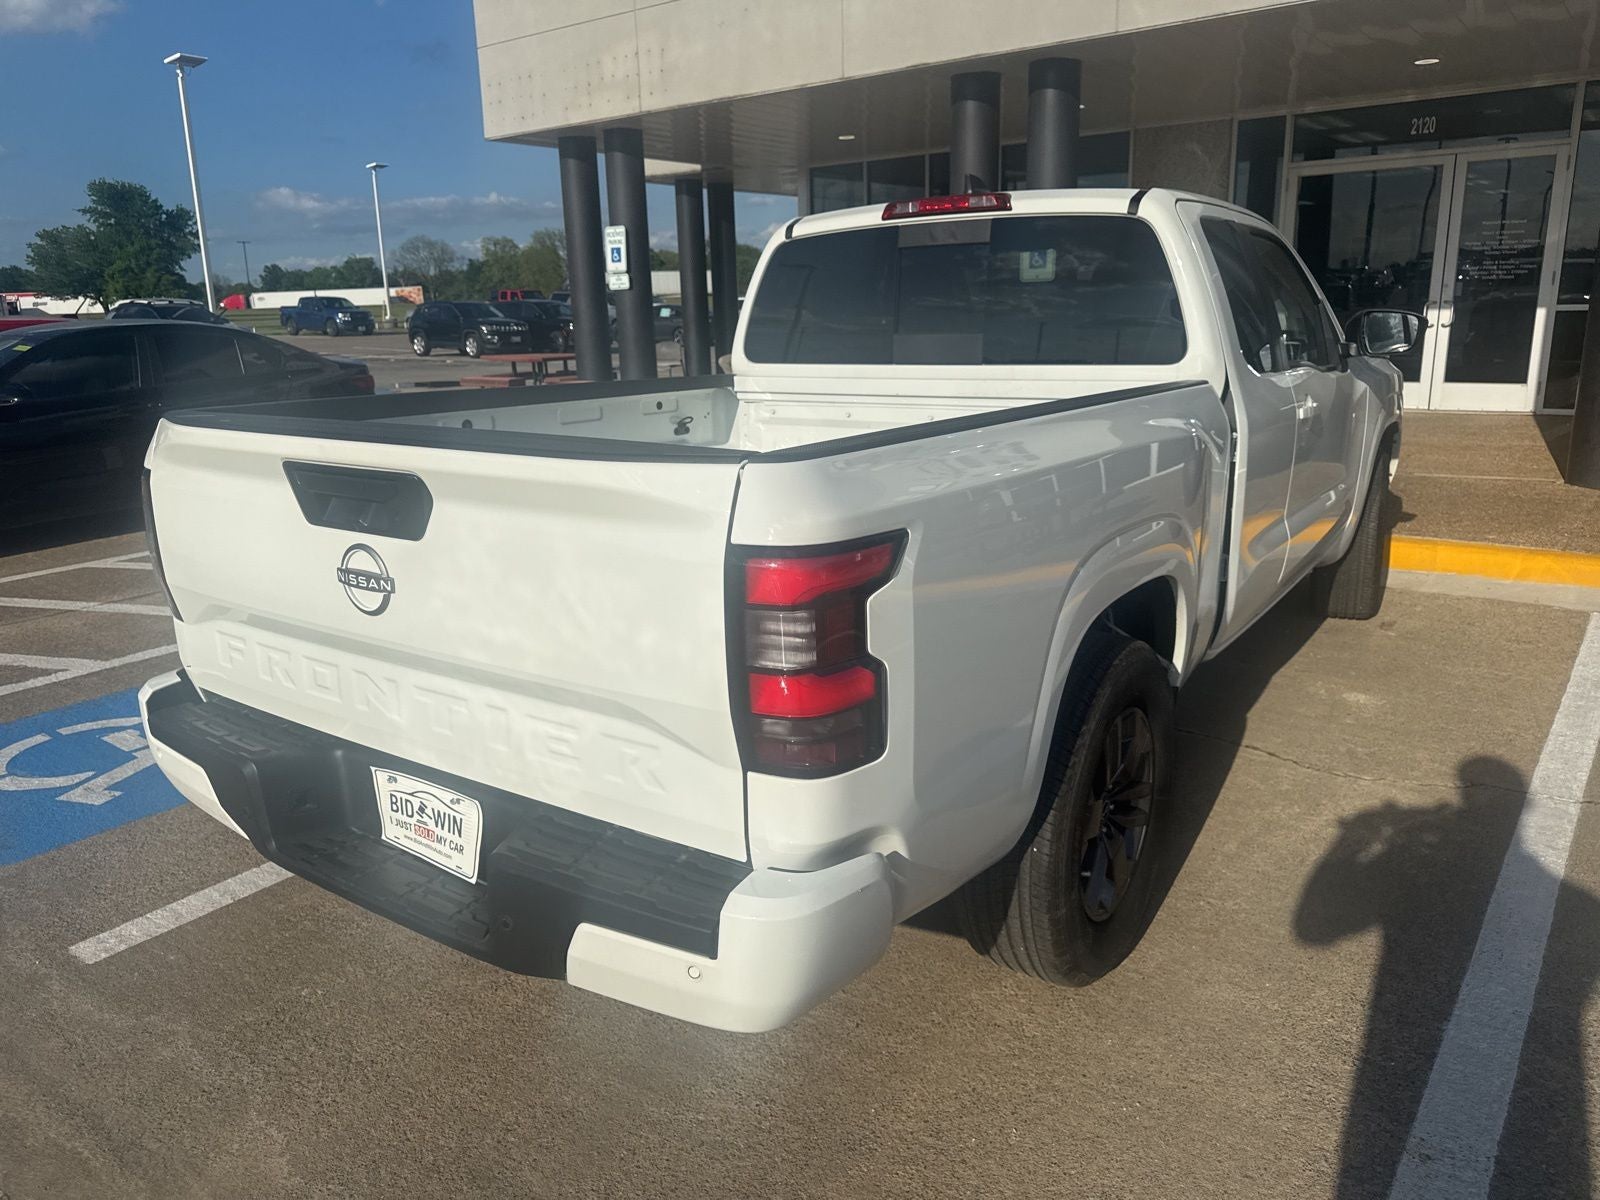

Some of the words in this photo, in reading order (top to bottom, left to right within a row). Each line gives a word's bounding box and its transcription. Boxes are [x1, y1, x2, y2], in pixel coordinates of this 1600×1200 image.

[1410, 116, 1436, 136] 2120
[337, 569, 392, 592] NISSAN
[216, 630, 668, 796] FRONTIER
[389, 793, 415, 818] BID
[431, 807, 463, 839] WIN
[389, 816, 393, 825] I
[395, 818, 412, 832] JUST
[414, 824, 436, 843] SOLD
[436, 834, 447, 847] MY
[449, 840, 465, 856] CAR
